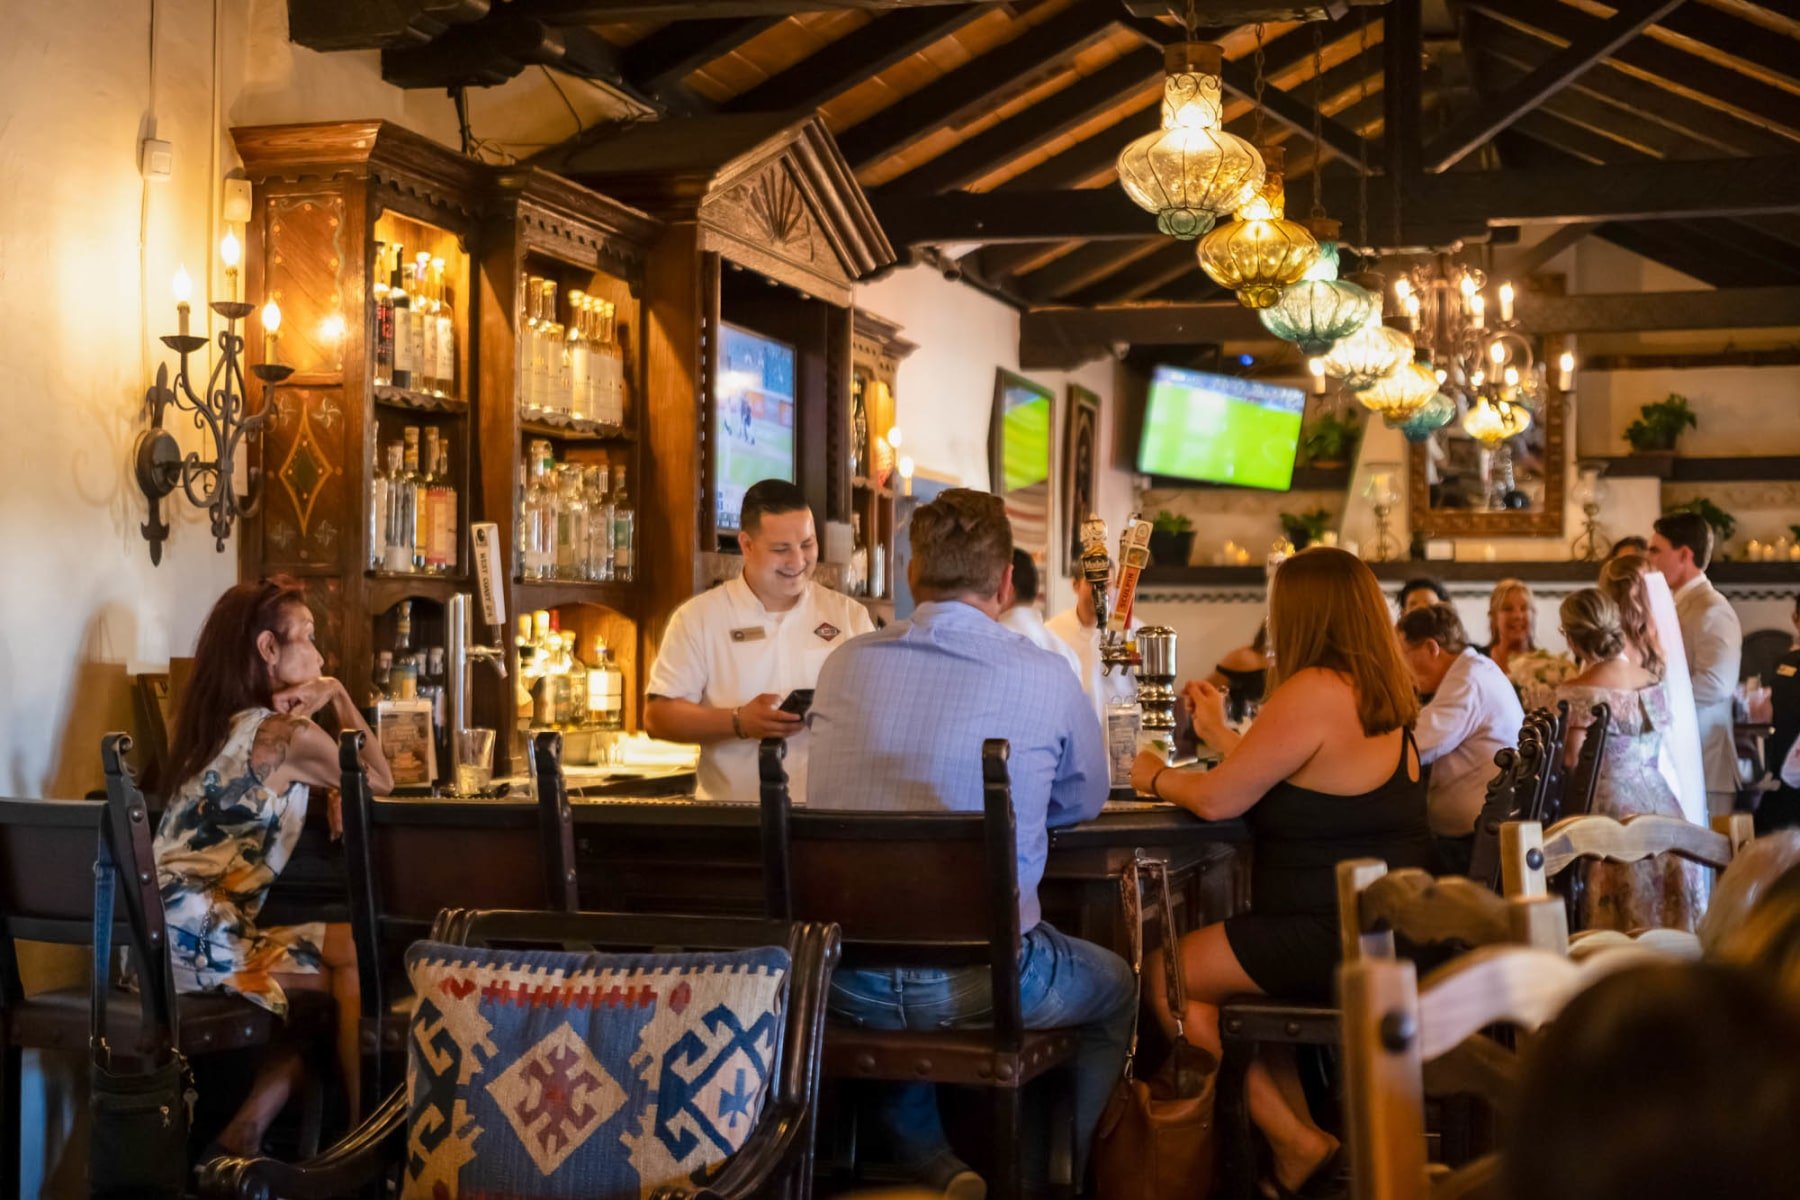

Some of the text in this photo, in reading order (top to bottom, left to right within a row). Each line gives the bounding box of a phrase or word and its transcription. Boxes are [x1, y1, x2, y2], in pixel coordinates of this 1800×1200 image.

[480, 553, 488, 573] WEST
[483, 578, 491, 600] COAST
[1120, 573, 1134, 608] SCULPIN
